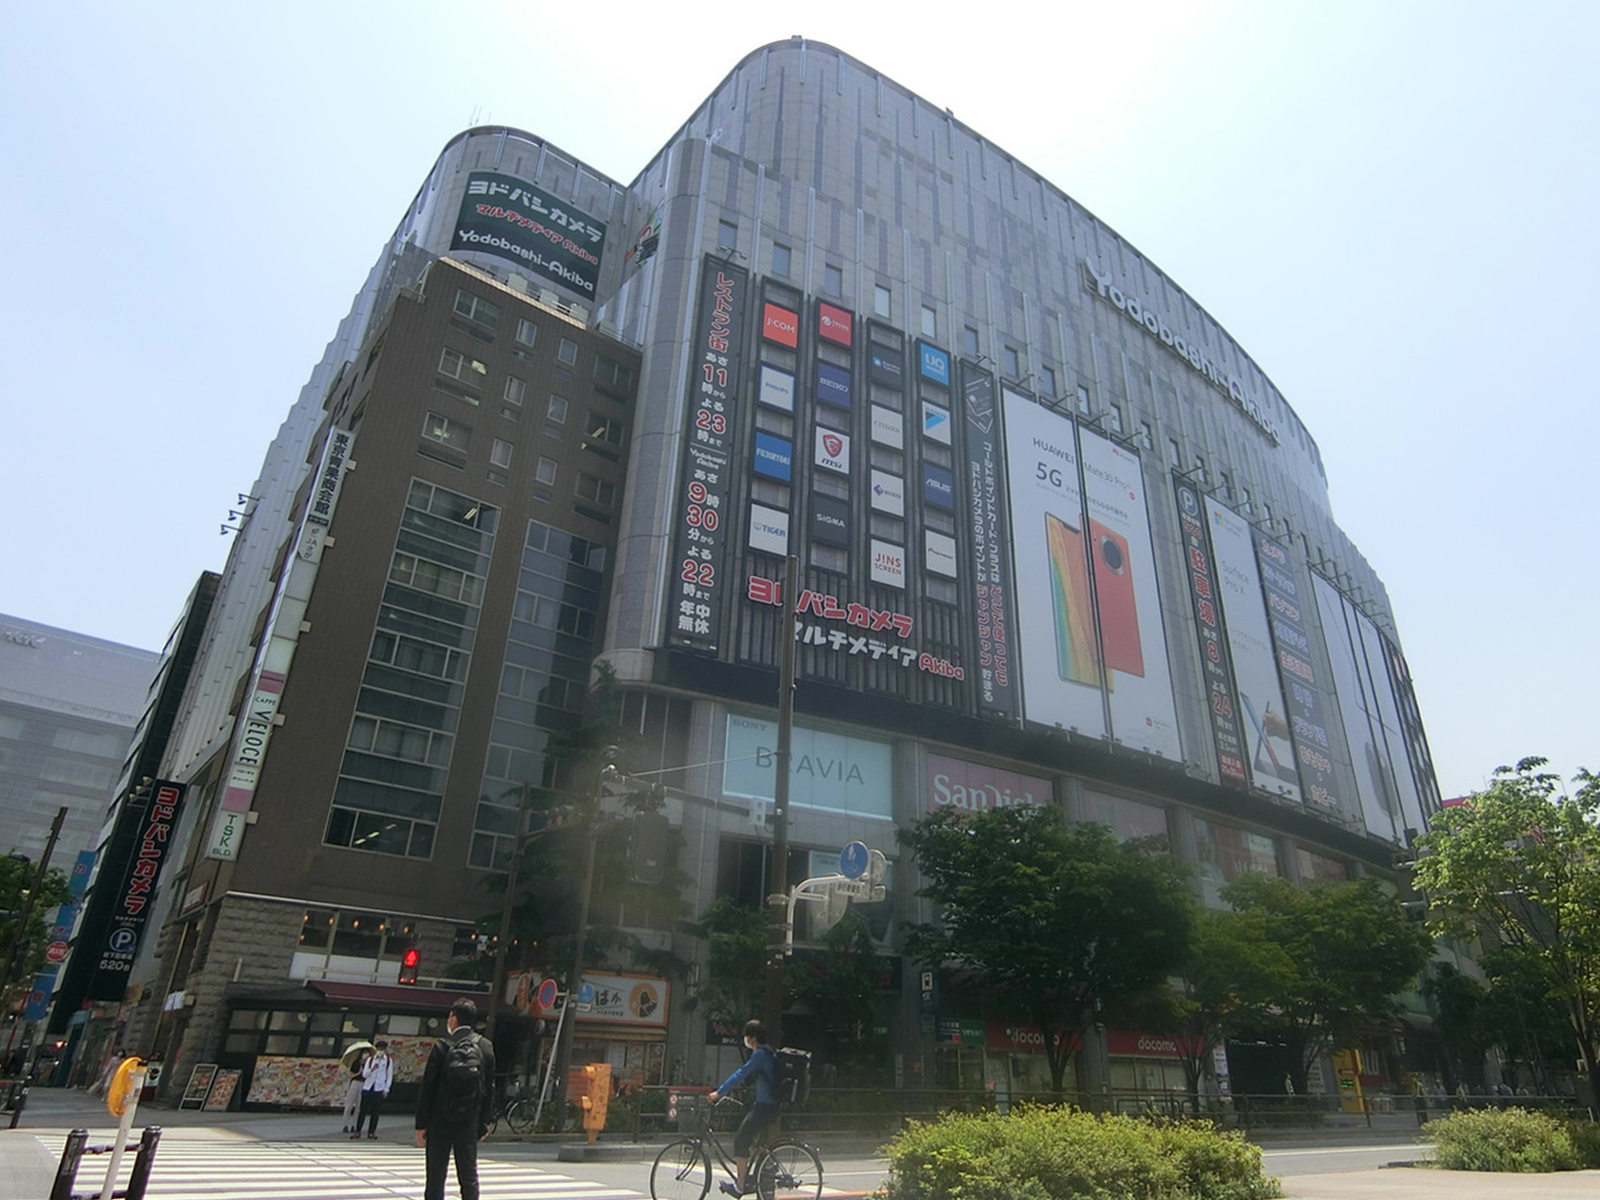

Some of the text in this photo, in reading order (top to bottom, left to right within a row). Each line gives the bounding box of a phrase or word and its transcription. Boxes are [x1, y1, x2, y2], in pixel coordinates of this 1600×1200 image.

[468, 180, 603, 242] ヨドバシカメラ
[476, 204, 598, 265] マルチメディア Akiba
[459, 229, 594, 292] Yodobashi-Akiba
[709, 272, 734, 353] レストラン街
[705, 352, 728, 367] あさ
[1084, 256, 1280, 446] Yodobashi-Akiba
[924, 353, 945, 371] UQ
[703, 364, 727, 387] 11
[820, 377, 849, 393] SEIKO
[701, 381, 726, 399] 時から
[701, 398, 724, 412] よる
[696, 409, 726, 434] 23
[874, 419, 901, 434] CITIZEN
[697, 429, 722, 447] 時まで
[1032, 437, 1075, 464] HUAWEI
[821, 458, 843, 469] msi
[694, 469, 719, 484] あさ
[1036, 461, 1062, 488] 5G
[926, 478, 951, 493] ASUS
[686, 504, 719, 531] 30
[816, 513, 845, 528] SIGMA
[688, 528, 714, 545] 分から
[762, 524, 786, 538] TIGER
[688, 546, 712, 561] よる
[681, 559, 714, 587] 22
[874, 562, 902, 576] SCREEN
[683, 582, 710, 600] 時まで
[680, 600, 711, 619] 年中
[678, 615, 710, 634] 無休
[919, 652, 965, 681] Akiba
[1212, 681, 1227, 694] よる
[1212, 692, 1232, 718] 24
[732, 718, 768, 731] SONY
[239, 711, 272, 765] VELOCE
[755, 745, 865, 786] BAVIA
[219, 814, 238, 848] TSK
[124, 786, 180, 915] ヨドバシカメラ
[1010, 1027, 1060, 1046] docoo
